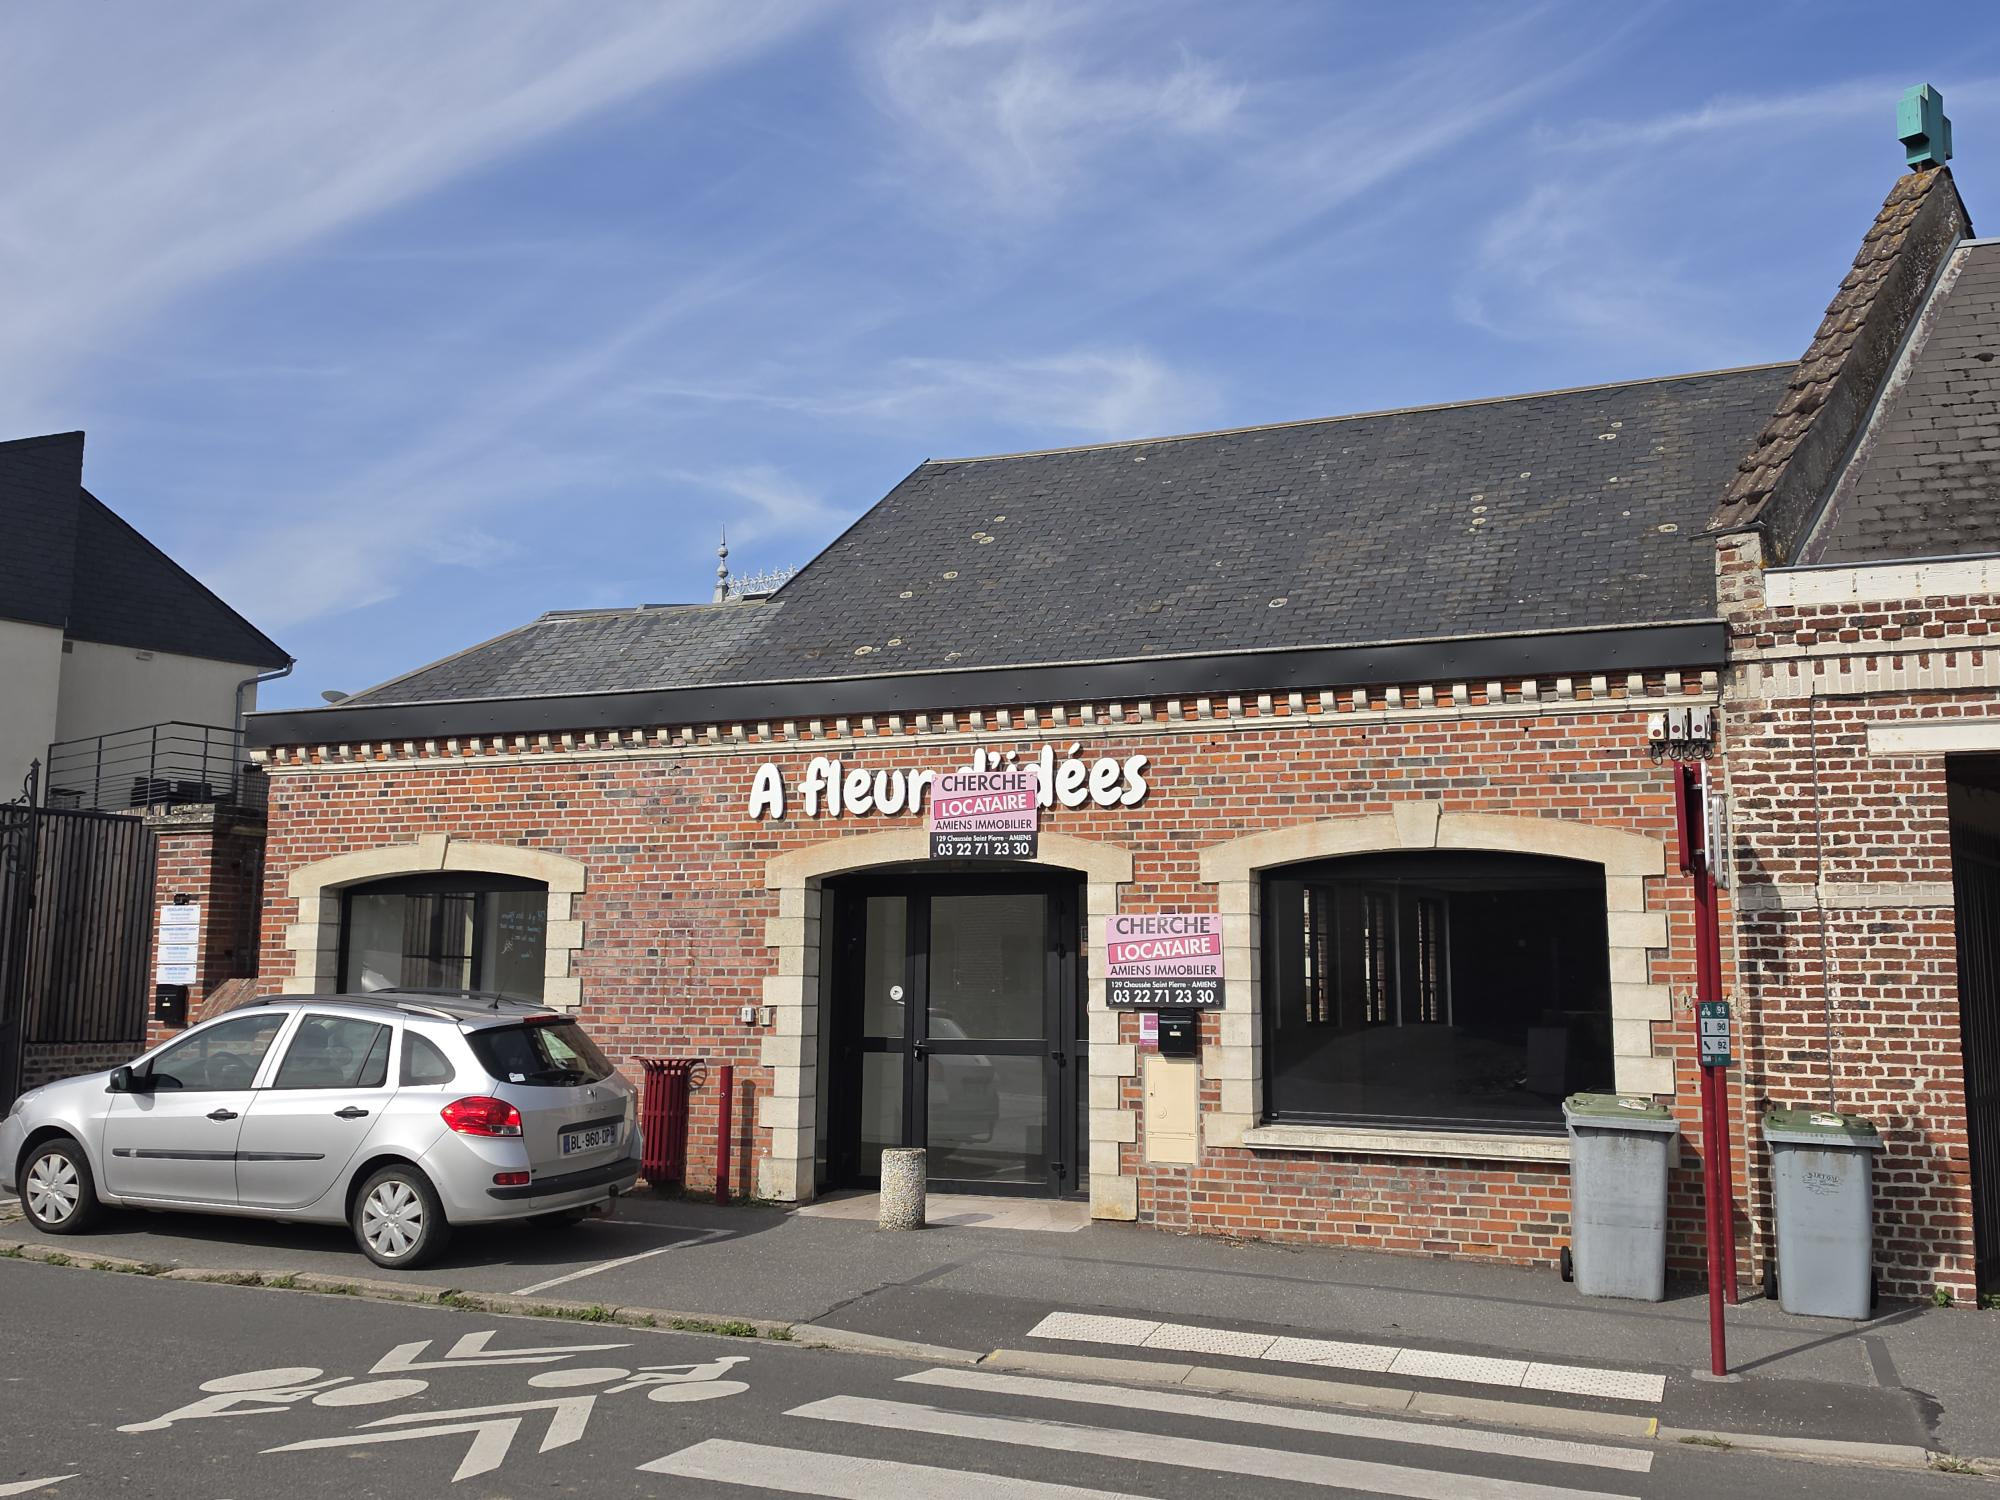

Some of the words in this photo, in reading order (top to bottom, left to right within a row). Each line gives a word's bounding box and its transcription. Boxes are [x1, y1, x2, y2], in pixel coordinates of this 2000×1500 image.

[750, 762, 783, 819] A
[798, 757, 935, 817] fleur
[942, 774, 1027, 792] CHERCHE
[942, 794, 1027, 817] LOCATAIRE
[936, 820, 972, 830] AMIENS
[975, 819, 1032, 830] IMMOBILIER
[988, 834, 1004, 842] Pierre
[1009, 834, 1032, 842] AMIENS
[938, 843, 953, 856] 03
[956, 843, 972, 856] 22
[975, 843, 989, 855] 71
[994, 843, 1009, 855] 23
[1013, 842, 1029, 855] 30
[1116, 916, 1210, 935] CHERCHE
[1117, 937, 1211, 961] LOCATAIRE
[1110, 965, 1151, 976] AMIENS
[1154, 964, 1217, 975] IMMOBILIER
[1123, 980, 1151, 988] Chaussée
[1192, 980, 1217, 988] AMIENS
[1113, 989, 1130, 1003] 03
[1134, 989, 1150, 1003] 22
[1154, 989, 1170, 1003] 71
[1175, 989, 1192, 1003] 23
[1196, 989, 1214, 1003] 30
